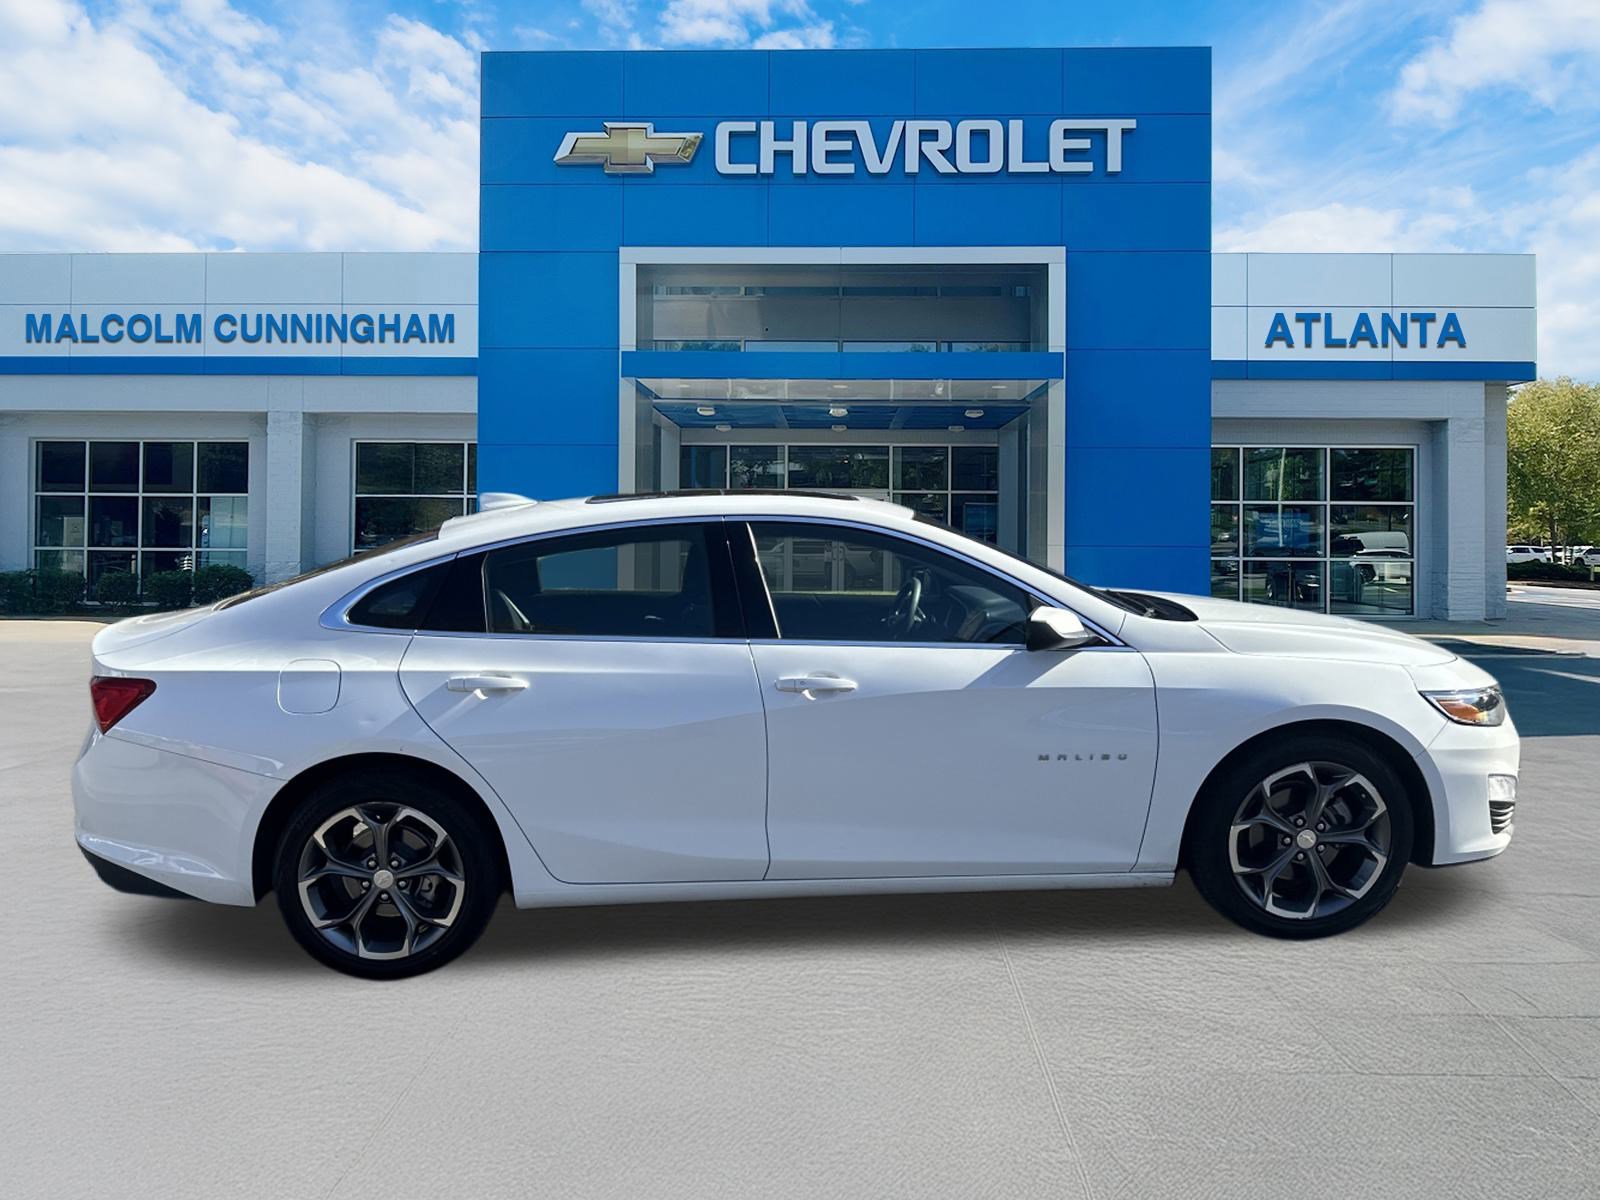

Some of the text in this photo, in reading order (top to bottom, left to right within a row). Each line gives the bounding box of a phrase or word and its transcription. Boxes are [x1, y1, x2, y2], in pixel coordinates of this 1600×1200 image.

[714, 119, 1137, 175] CHEVROLET
[25, 313, 456, 343] MALCOLM CUNNINGHAM
[1265, 312, 1467, 348] ATLANTA
[1038, 753, 1128, 761] MALIBU
